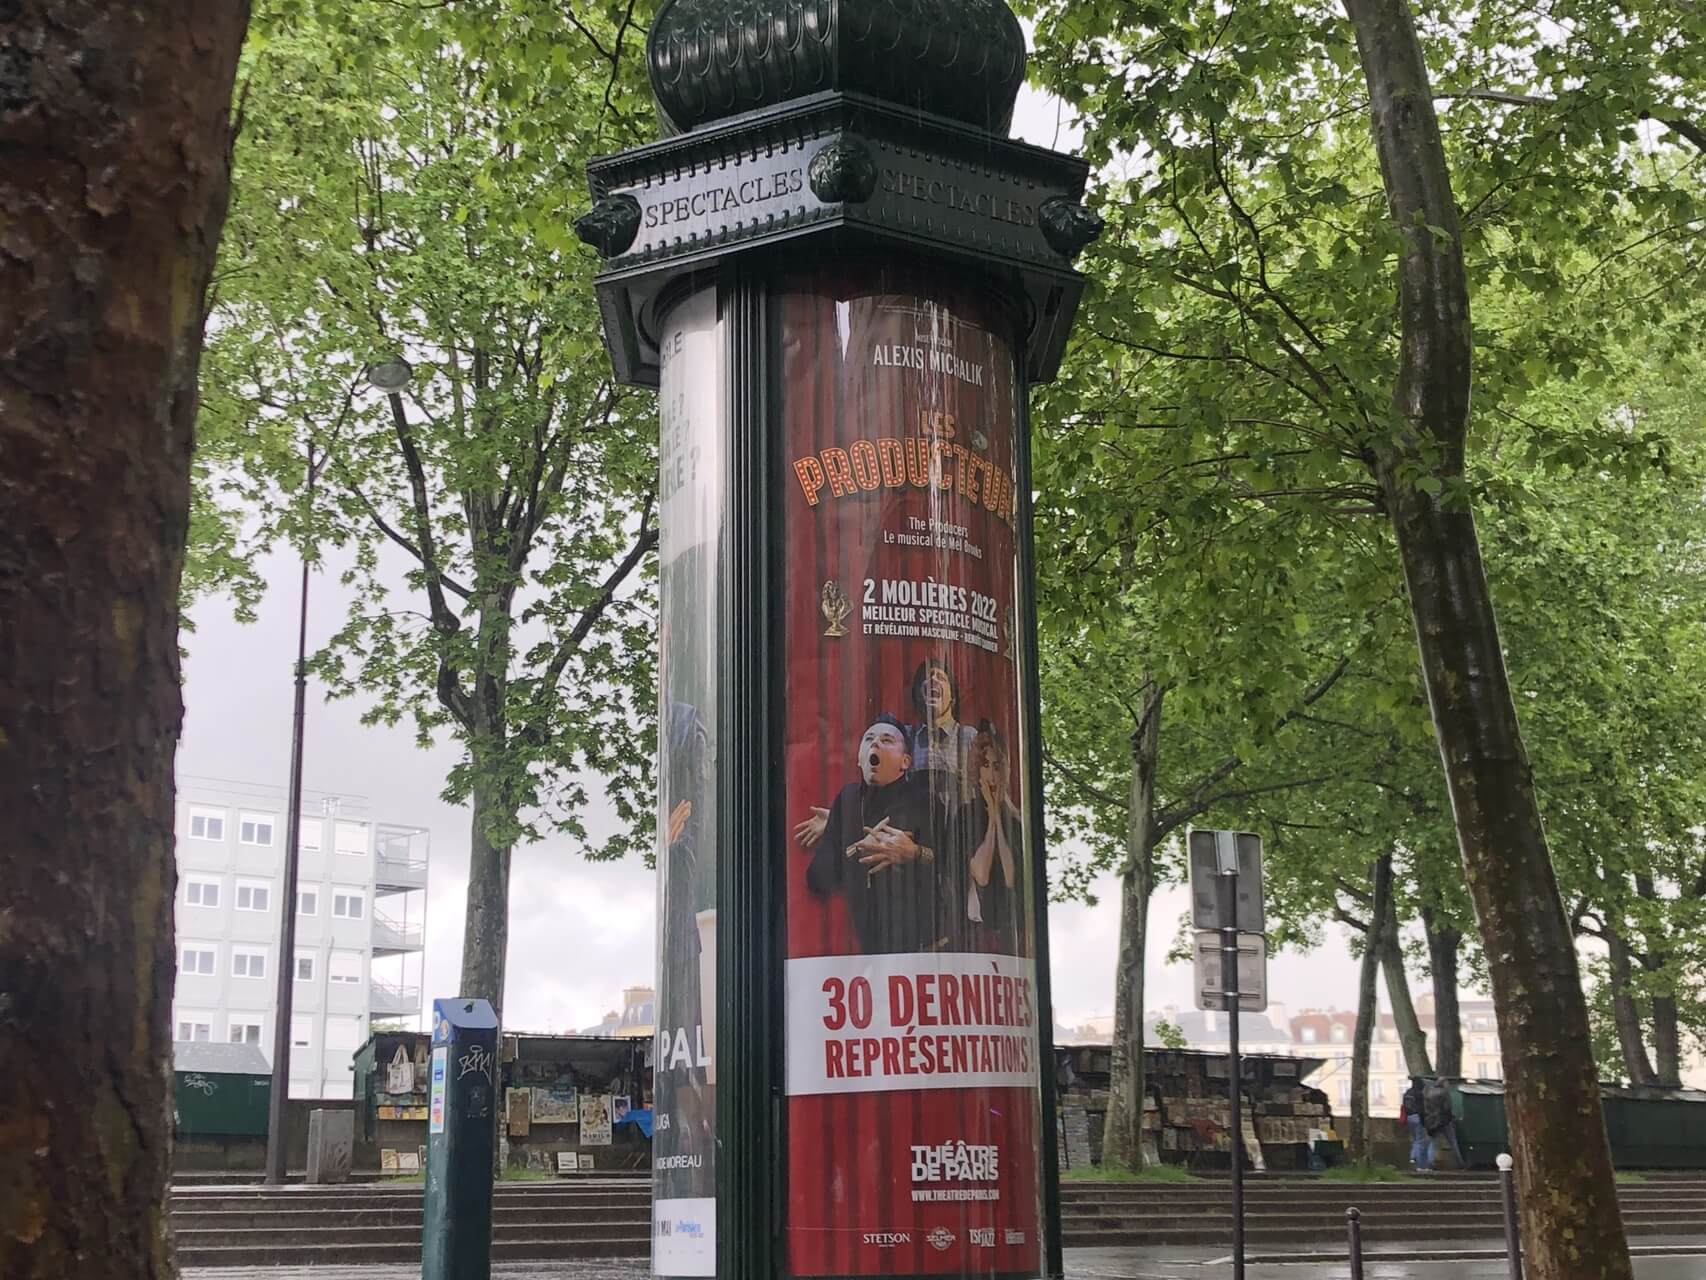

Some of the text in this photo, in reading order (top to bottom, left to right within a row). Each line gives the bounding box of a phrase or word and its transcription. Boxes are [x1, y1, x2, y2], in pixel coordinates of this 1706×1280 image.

[645, 168, 803, 228] SPECTACLES
[880, 168, 1037, 226] SPECTACLES
[873, 344, 983, 387] ALEXIS MICHALIK
[921, 410, 956, 439] LES
[883, 531, 895, 545] Le
[897, 531, 934, 547] musical
[936, 532, 947, 549] de
[949, 536, 963, 552] Mel
[909, 516, 969, 539] The Producers
[863, 575, 998, 623] 2 MOLIÈRES 2022
[862, 605, 999, 640] MEILLEUR SPECTACLE MUSICAL
[863, 623, 873, 635] ET
[875, 621, 920, 637] RÉVÉLATION
[921, 626, 960, 641] MASCULINE
[822, 961, 1033, 1031] 30 DERNIÈRES
[824, 1026, 1028, 1079] REPRÉSENTATIONS
[910, 1140, 999, 1166] THÉÂTRE
[911, 1162, 999, 1182] DE PARIS
[863, 1231, 912, 1245] STETSON
